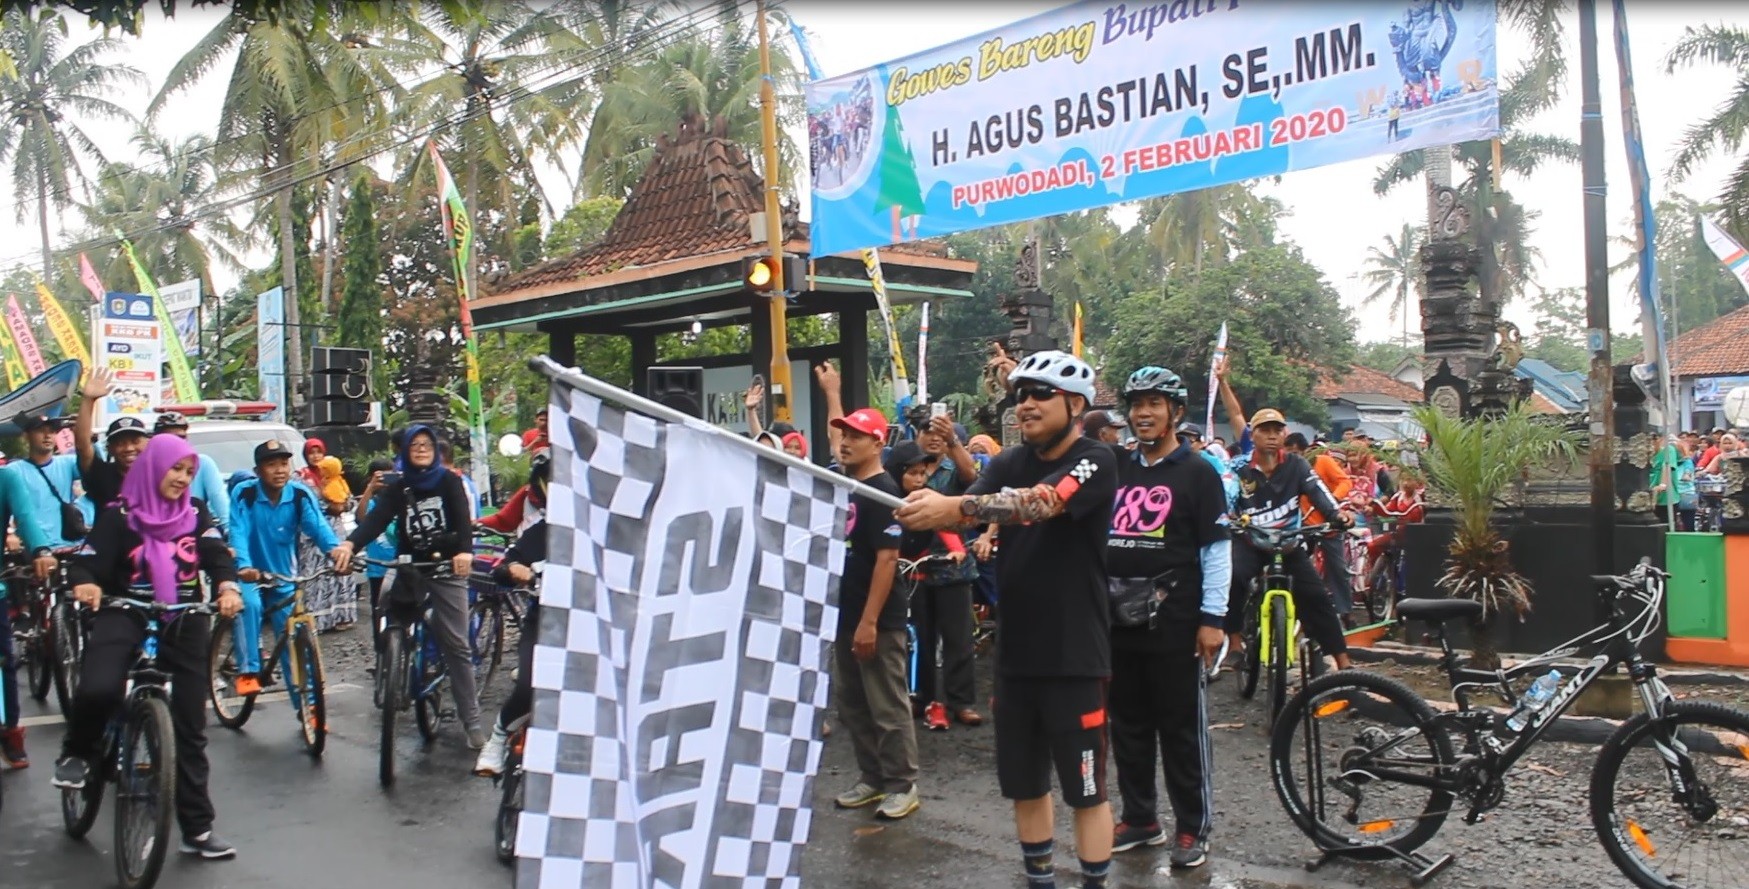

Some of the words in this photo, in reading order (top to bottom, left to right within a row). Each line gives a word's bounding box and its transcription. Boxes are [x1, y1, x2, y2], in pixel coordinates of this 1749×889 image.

[886, 57, 973, 107] Gowes
[977, 21, 1097, 82] Bareng
[931, 128, 958, 167] H.
[966, 104, 1045, 159] AGUS
[1054, 64, 1209, 142] BASTIAN,
[952, 160, 1095, 208] PURWODADI,
[1101, 156, 1116, 179] 2
[1123, 125, 1261, 174] FEBRUARI
[1271, 107, 1346, 146] 2020
